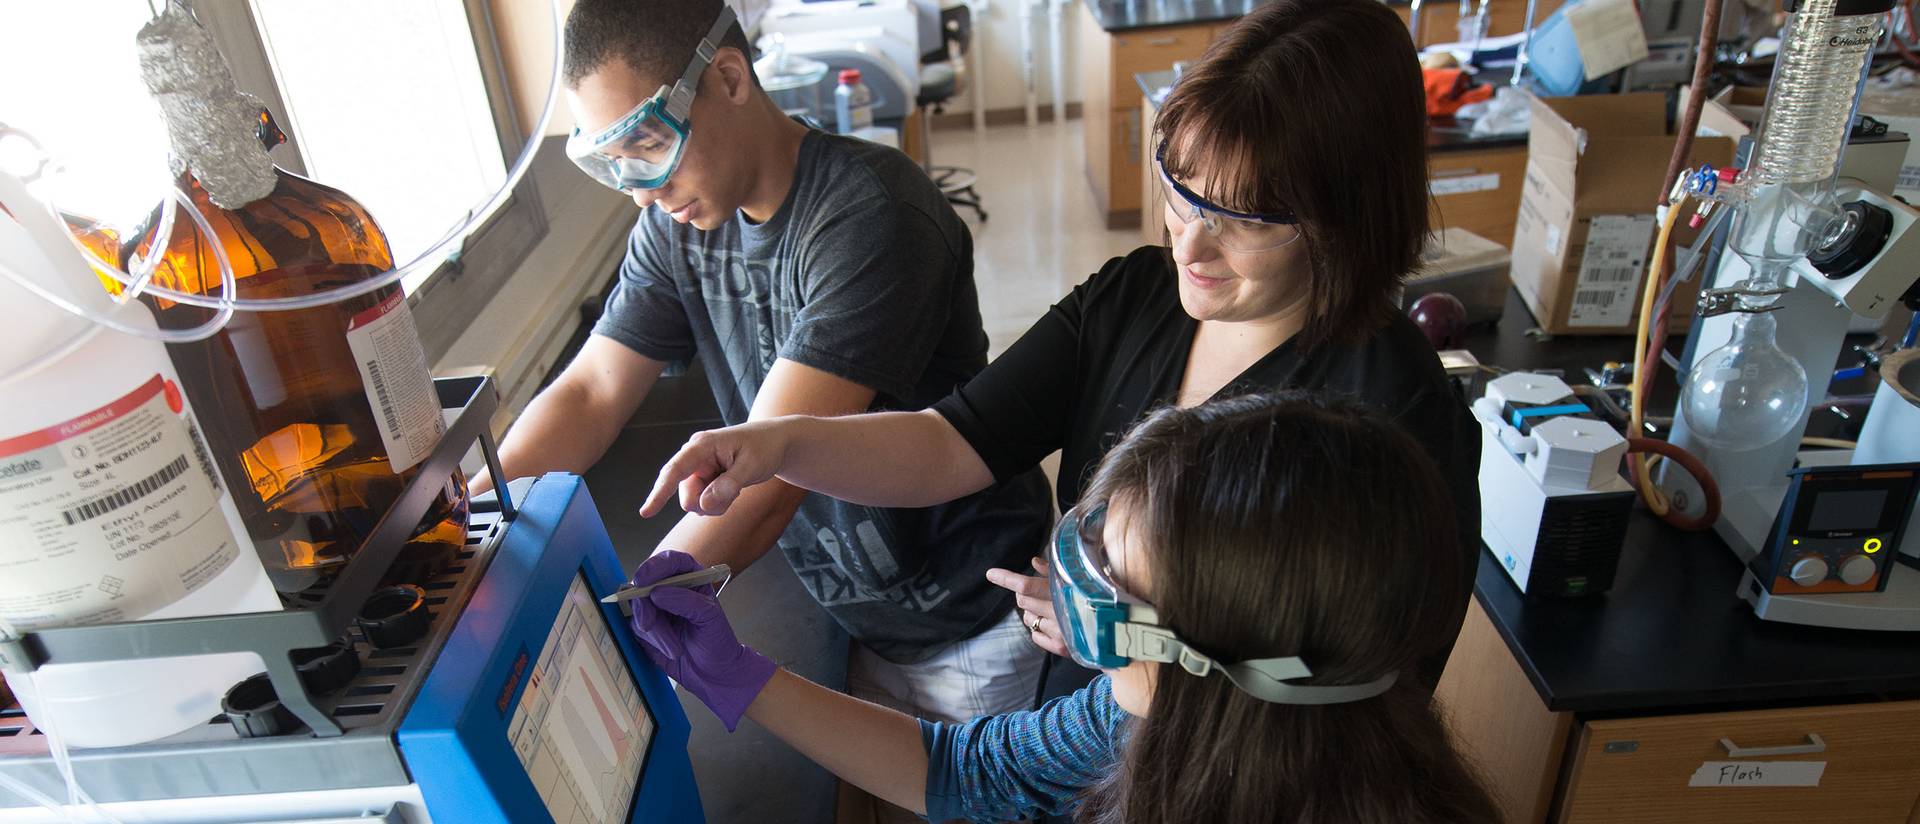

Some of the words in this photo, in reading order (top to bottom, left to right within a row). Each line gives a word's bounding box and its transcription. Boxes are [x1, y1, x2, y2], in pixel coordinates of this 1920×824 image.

[143, 485, 187, 513] Acetate
[115, 549, 137, 561] Date
[1718, 764, 1763, 784] Flash
